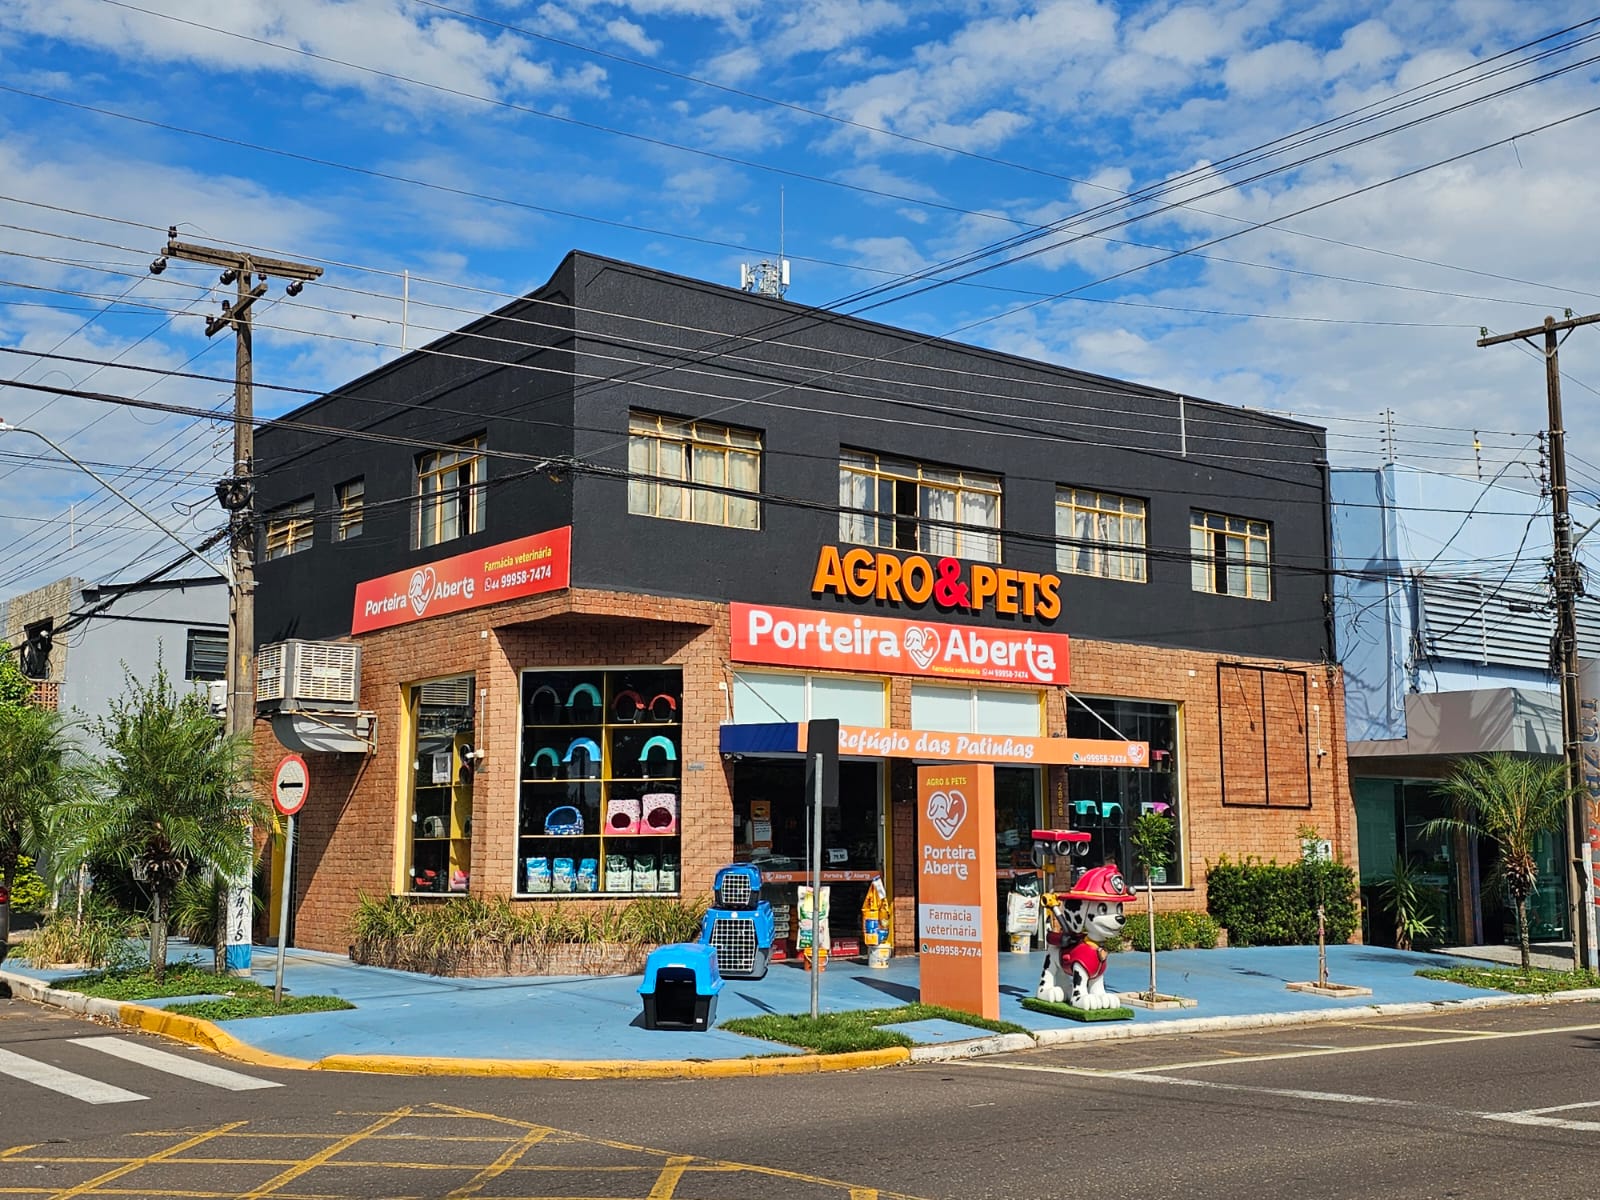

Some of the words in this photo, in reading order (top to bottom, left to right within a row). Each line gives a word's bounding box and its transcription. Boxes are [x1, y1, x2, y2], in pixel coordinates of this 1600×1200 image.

[484, 557, 514, 572] Farmácia
[514, 546, 552, 565] veterinária
[491, 581, 499, 589] 44
[501, 565, 552, 588] 99958-7474
[364, 592, 407, 617] Porteira
[433, 576, 475, 600] Aberta
[749, 609, 901, 658] Porteira
[943, 628, 1057, 682] Aberta
[838, 728, 909, 752] Refúgio
[915, 733, 950, 754] das
[956, 735, 1035, 758] Patinhas
[926, 777, 944, 786] AGRO
[945, 777, 950, 785] &
[951, 776, 967, 785] PETS
[923, 845, 976, 860] Porteira
[923, 860, 968, 881] Aberta
[928, 908, 972, 921] Farmácia
[926, 924, 977, 937] veterinária
